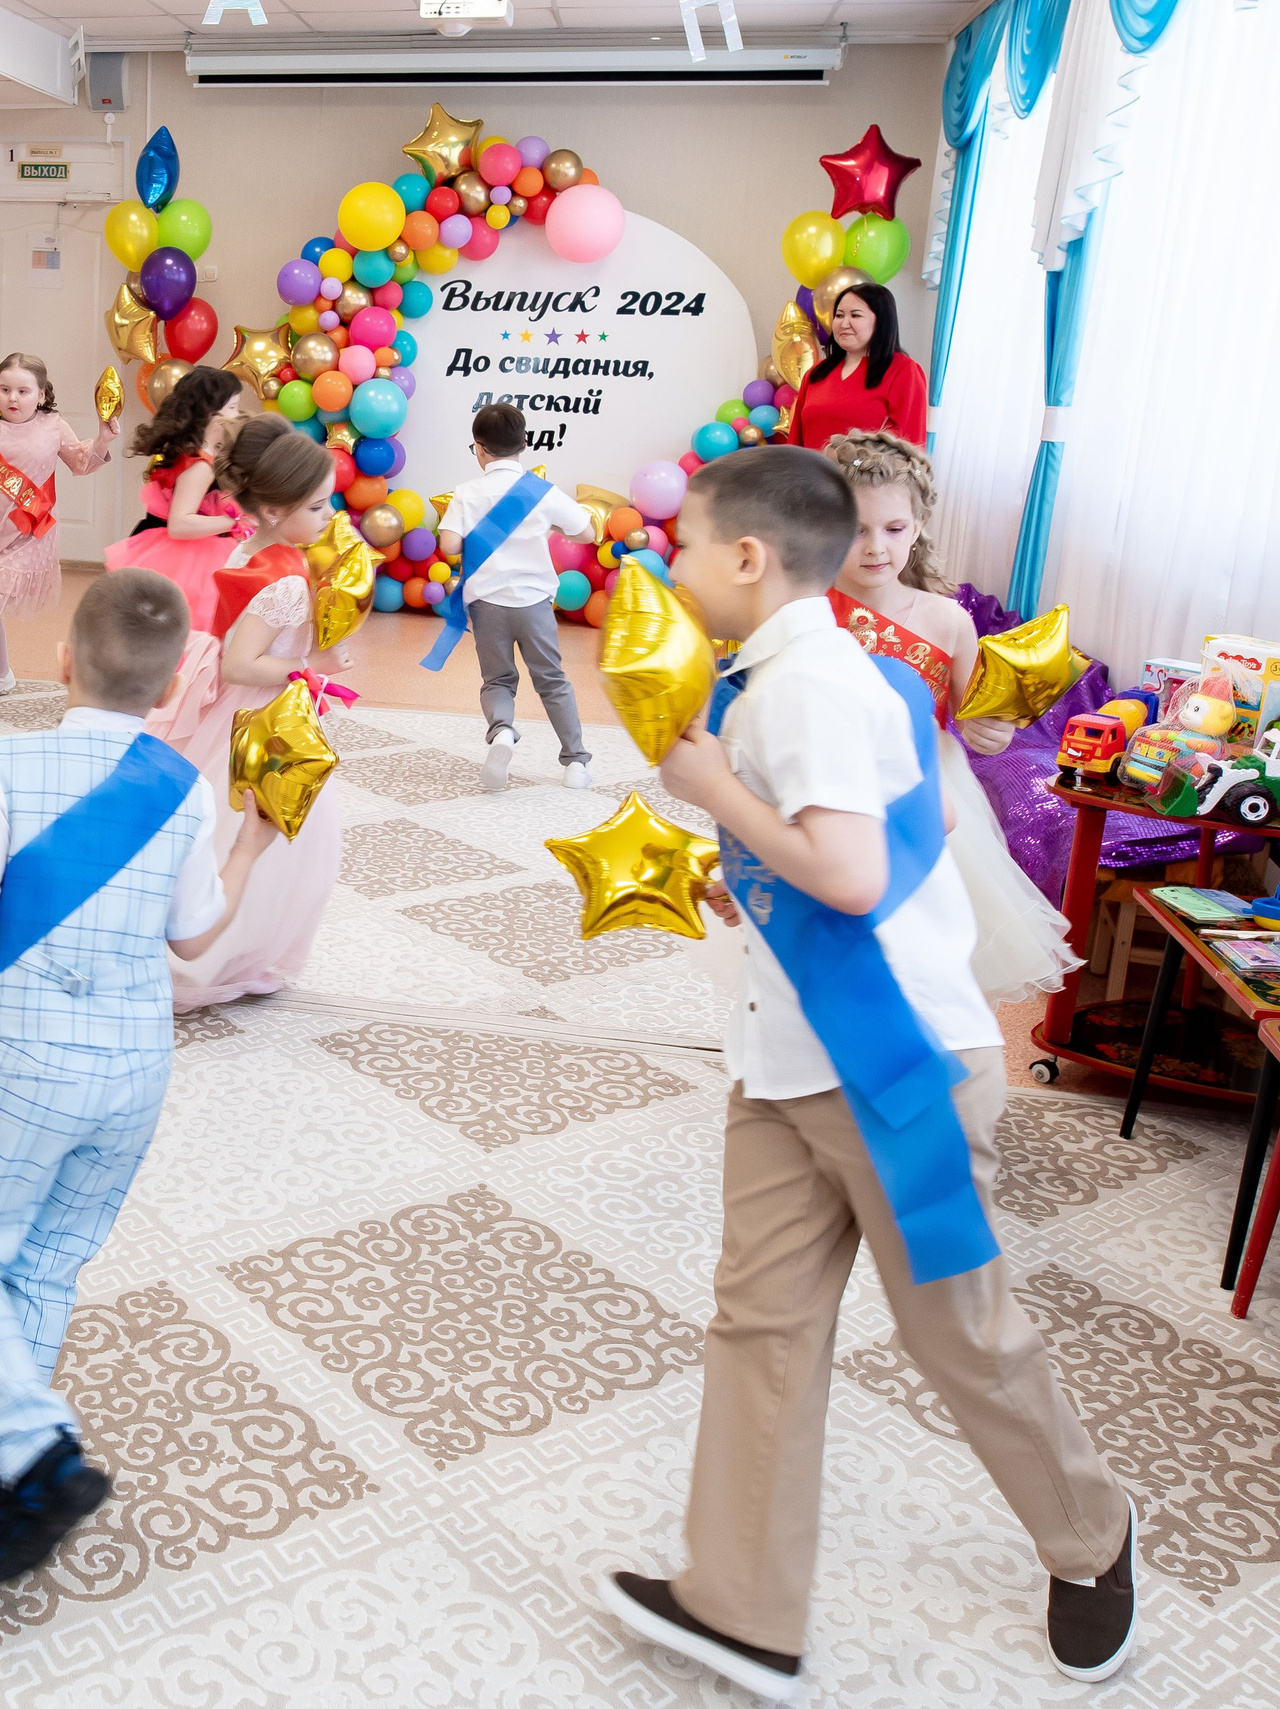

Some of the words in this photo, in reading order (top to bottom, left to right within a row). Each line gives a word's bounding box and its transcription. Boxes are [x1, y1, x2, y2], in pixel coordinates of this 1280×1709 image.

[9, 149, 14, 162] 1
[23, 165, 66, 178] ВЫХОД
[440, 279, 601, 322] Выпуск
[616, 290, 706, 317] 2024
[446, 347, 491, 377] До
[498, 356, 655, 381] свидания,
